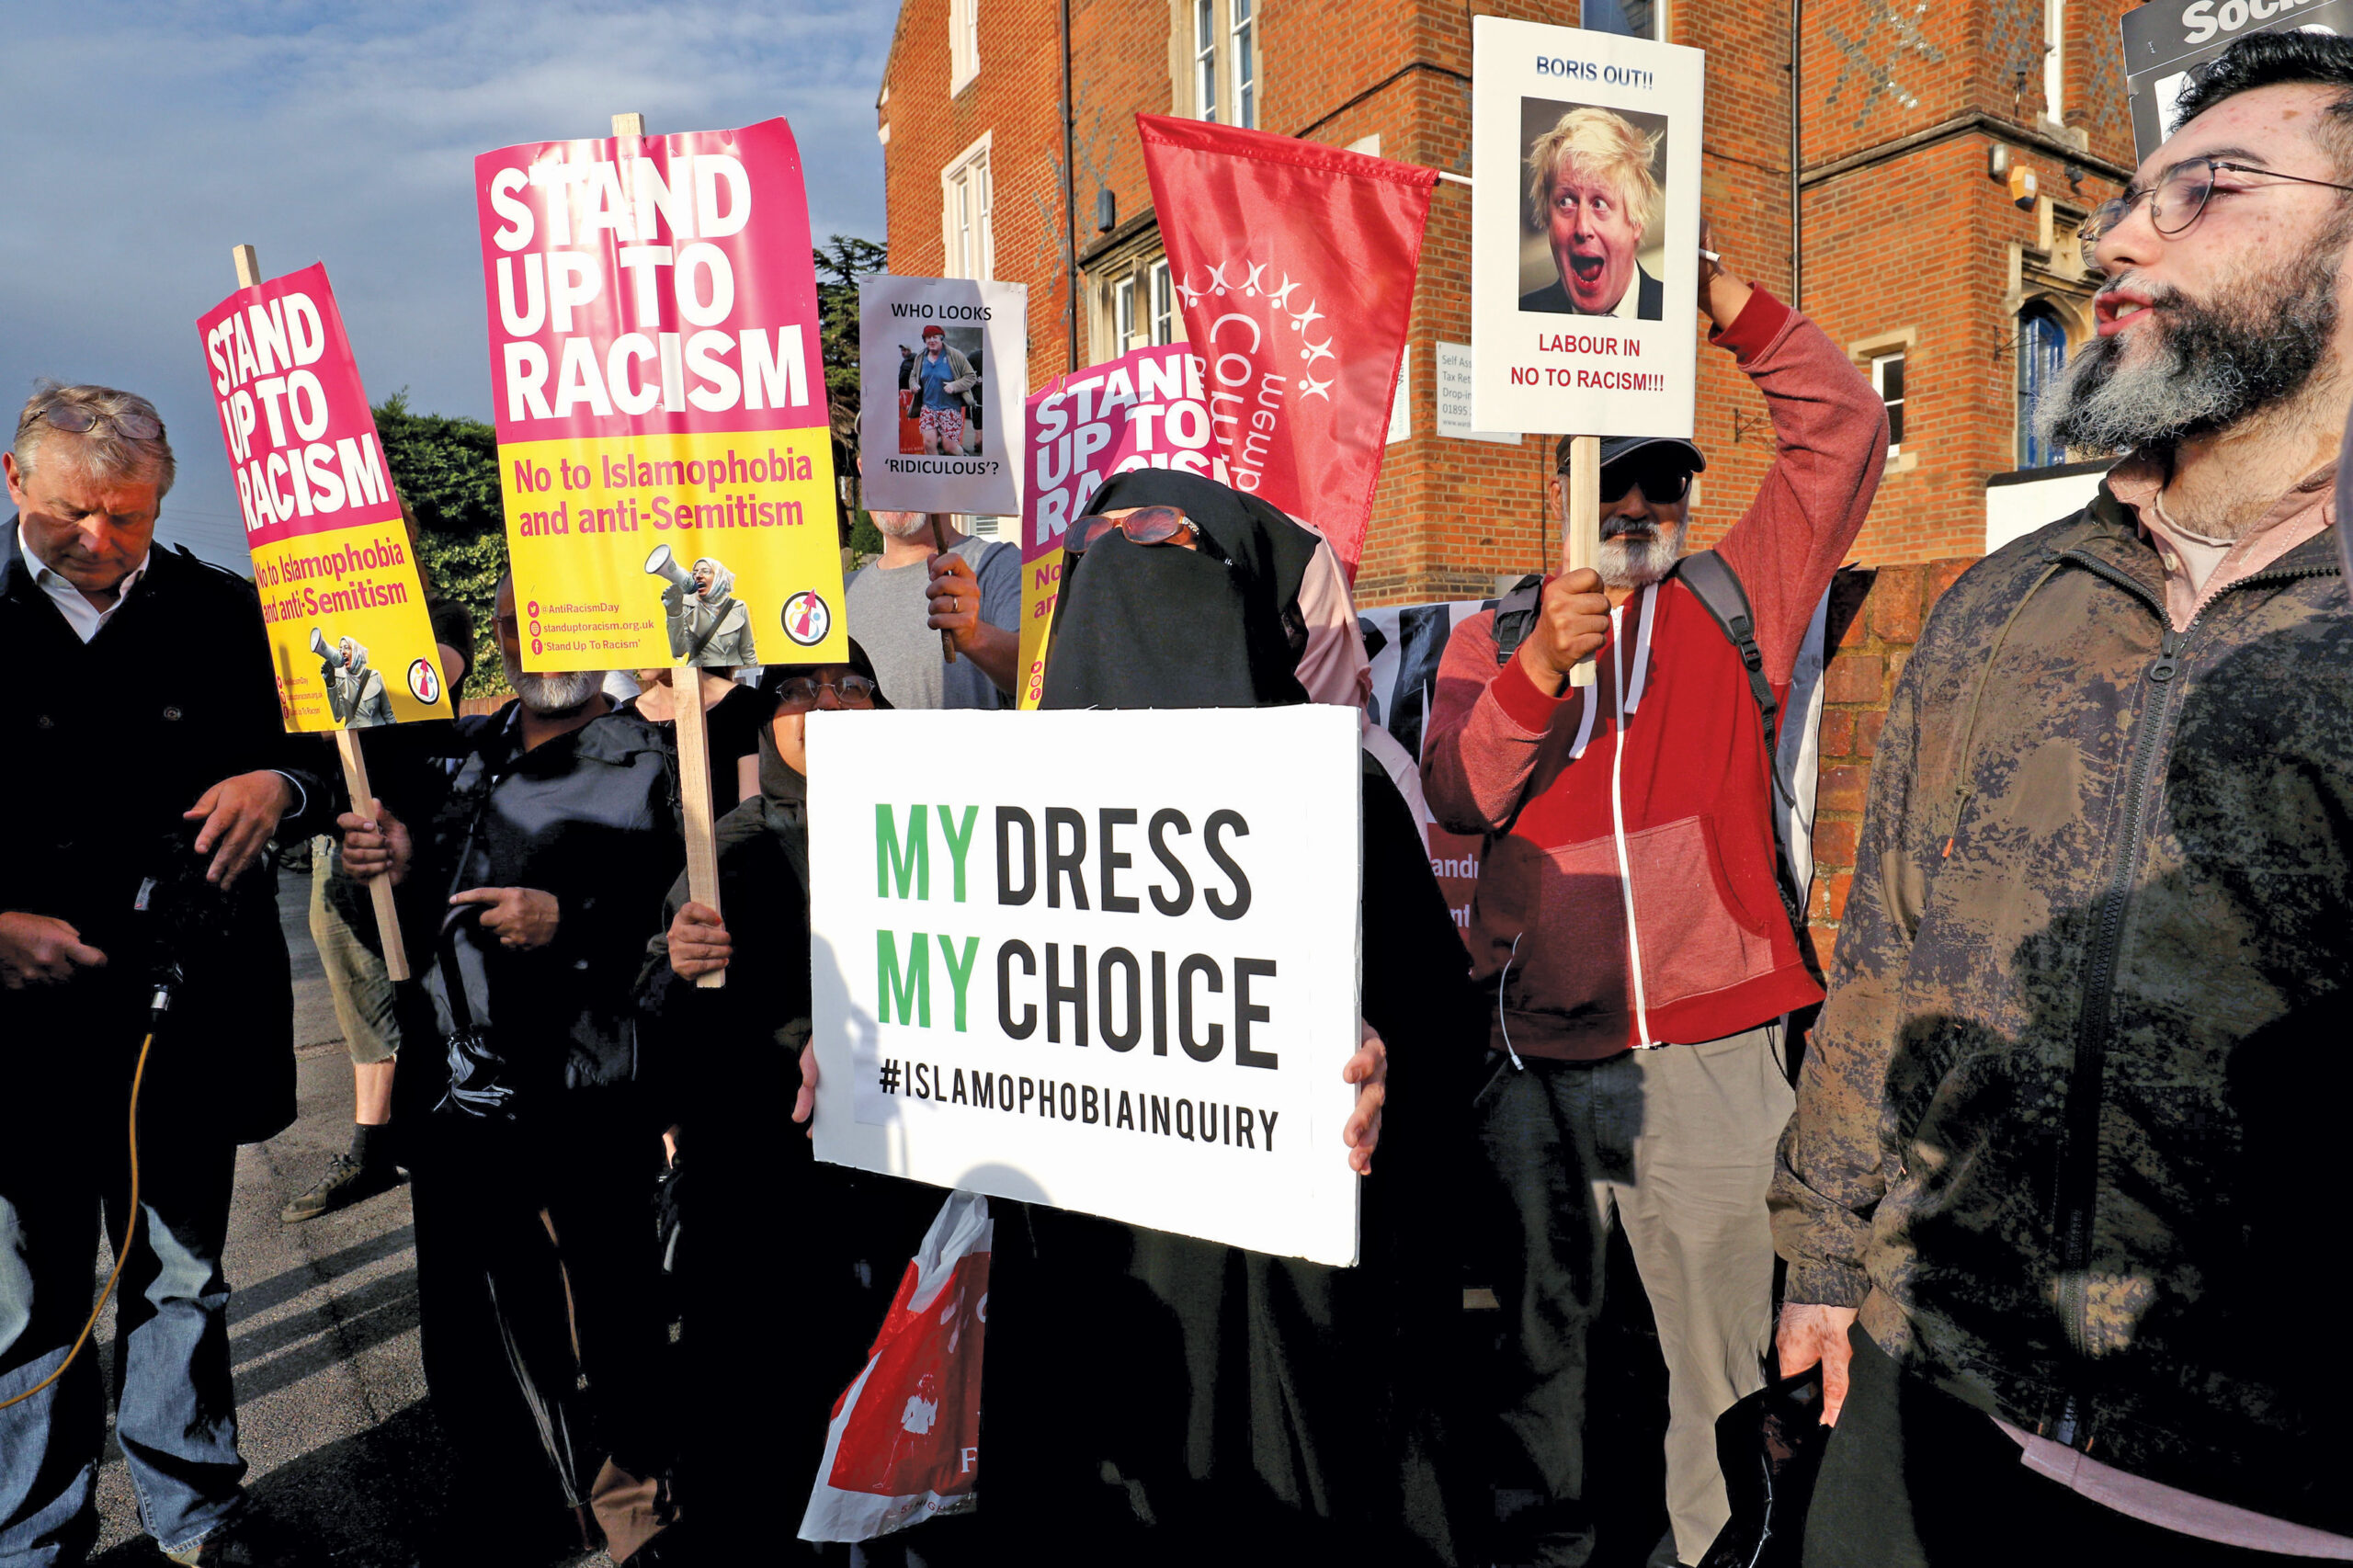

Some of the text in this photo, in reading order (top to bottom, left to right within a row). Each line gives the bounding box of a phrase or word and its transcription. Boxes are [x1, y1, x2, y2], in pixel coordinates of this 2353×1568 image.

[2182, 0, 2309, 43] Soc
[1536, 55, 1654, 90] BORIS OUT!!
[490, 153, 752, 251] STAND
[496, 242, 734, 337] UP TO
[891, 303, 993, 321] WHO LOOKS
[208, 292, 325, 397] STAND
[1442, 355, 1458, 366] Self
[1539, 334, 1641, 357] LABOUR IN
[503, 324, 810, 422] RACISM
[1443, 371, 1456, 381] Tax
[1510, 367, 1665, 392] NO TO RACISM!!!
[221, 369, 329, 464] UP TO
[1442, 403, 1468, 415] 01895
[1037, 400, 1211, 492] UP TO
[237, 433, 390, 532] RACISM
[514, 448, 813, 493] No to Islamophobia
[520, 494, 804, 537] and anti-Semitism
[255, 537, 405, 589] No to Islamophobia
[1035, 563, 1063, 591] No
[264, 579, 407, 624] and anti-Semitism
[542, 603, 620, 614] @AntiRacismDay
[543, 619, 654, 633] standuptoracism.org.uk
[573, 642, 586, 652] Up
[589, 640, 601, 650] To
[875, 803, 1252, 921] MY DRESS
[876, 929, 1279, 1071] MY CHOICE
[879, 1058, 1279, 1153] #ISLAMOPHOBIAINQUIRY
